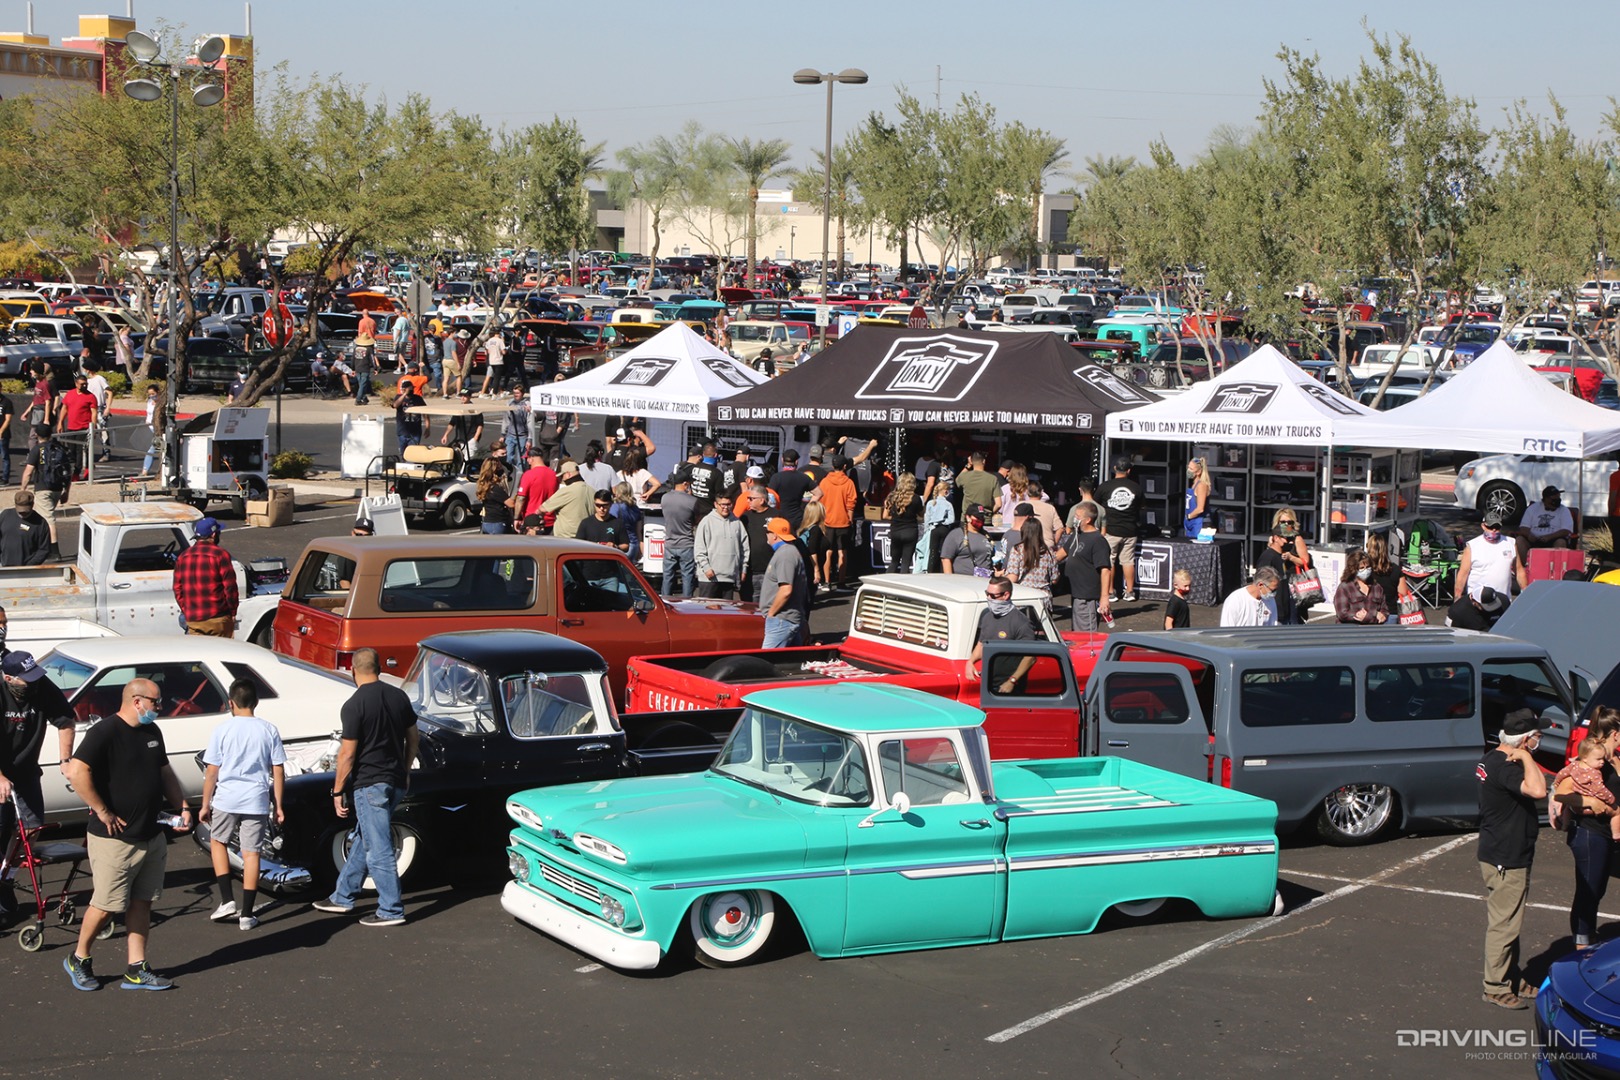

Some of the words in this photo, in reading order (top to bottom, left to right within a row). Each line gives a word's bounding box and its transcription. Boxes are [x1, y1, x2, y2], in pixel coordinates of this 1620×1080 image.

[264, 316, 292, 334] STP
[909, 317, 928, 329] STOP
[900, 364, 945, 384] ONLY
[555, 394, 570, 405] YOU
[571, 396, 585, 406] CAN
[586, 396, 610, 407] NEVER
[611, 397, 631, 409] HAVE
[633, 399, 646, 410] TOO
[647, 401, 670, 411] MANY
[671, 402, 700, 414] TRUCKS
[1224, 397, 1251, 408] ONLY
[735, 408, 750, 419] YOU
[751, 408, 767, 419] CAN
[768, 408, 793, 419] NEVER
[794, 408, 815, 419] HAVE
[816, 408, 831, 420] TOO
[832, 409, 855, 420] MANY
[857, 409, 887, 421] TRUCKS
[908, 410, 924, 422] YOU
[925, 410, 942, 422] CAN
[943, 410, 970, 423] NEVER
[971, 410, 995, 423] HAVE
[996, 411, 1012, 423] TOO
[1013, 412, 1039, 425] MANY
[1040, 413, 1074, 426] TRUCKS
[1138, 421, 1156, 432] YOU
[1158, 422, 1176, 433] CAN
[1178, 422, 1207, 434] NEVER
[1209, 423, 1234, 435] HAVE
[1236, 424, 1254, 436] TOO
[1255, 425, 1283, 437] MANY
[1286, 425, 1322, 438] TRUCKS
[1523, 438, 1567, 453] RTIC
[1138, 564, 1156, 579] ONLY
[648, 690, 710, 712] CHEVRO
